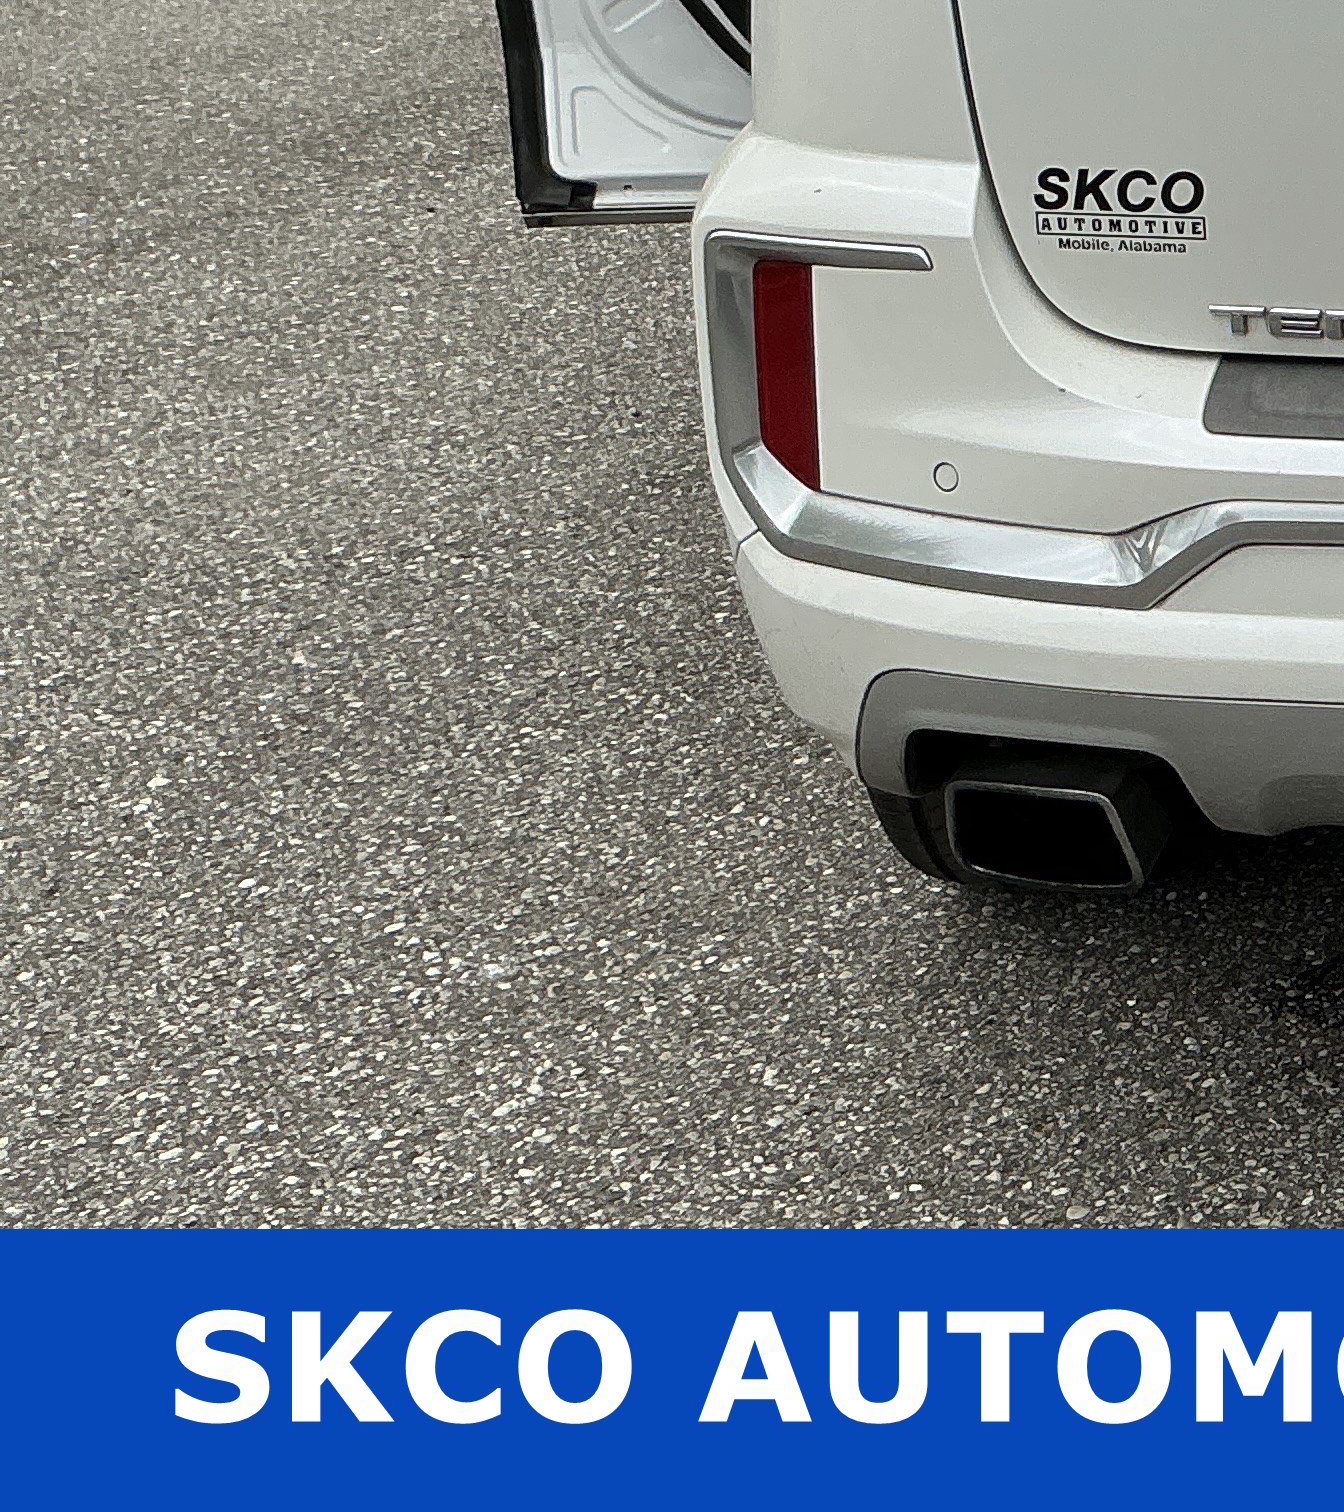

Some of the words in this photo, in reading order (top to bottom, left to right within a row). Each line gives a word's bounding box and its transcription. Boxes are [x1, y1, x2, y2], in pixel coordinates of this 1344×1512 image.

[1033, 167, 1205, 214] SKCO
[1040, 216, 1203, 235] AUTOMOTIVE
[1057, 238, 1115, 253] Mobile,
[1117, 239, 1187, 254] Alabama
